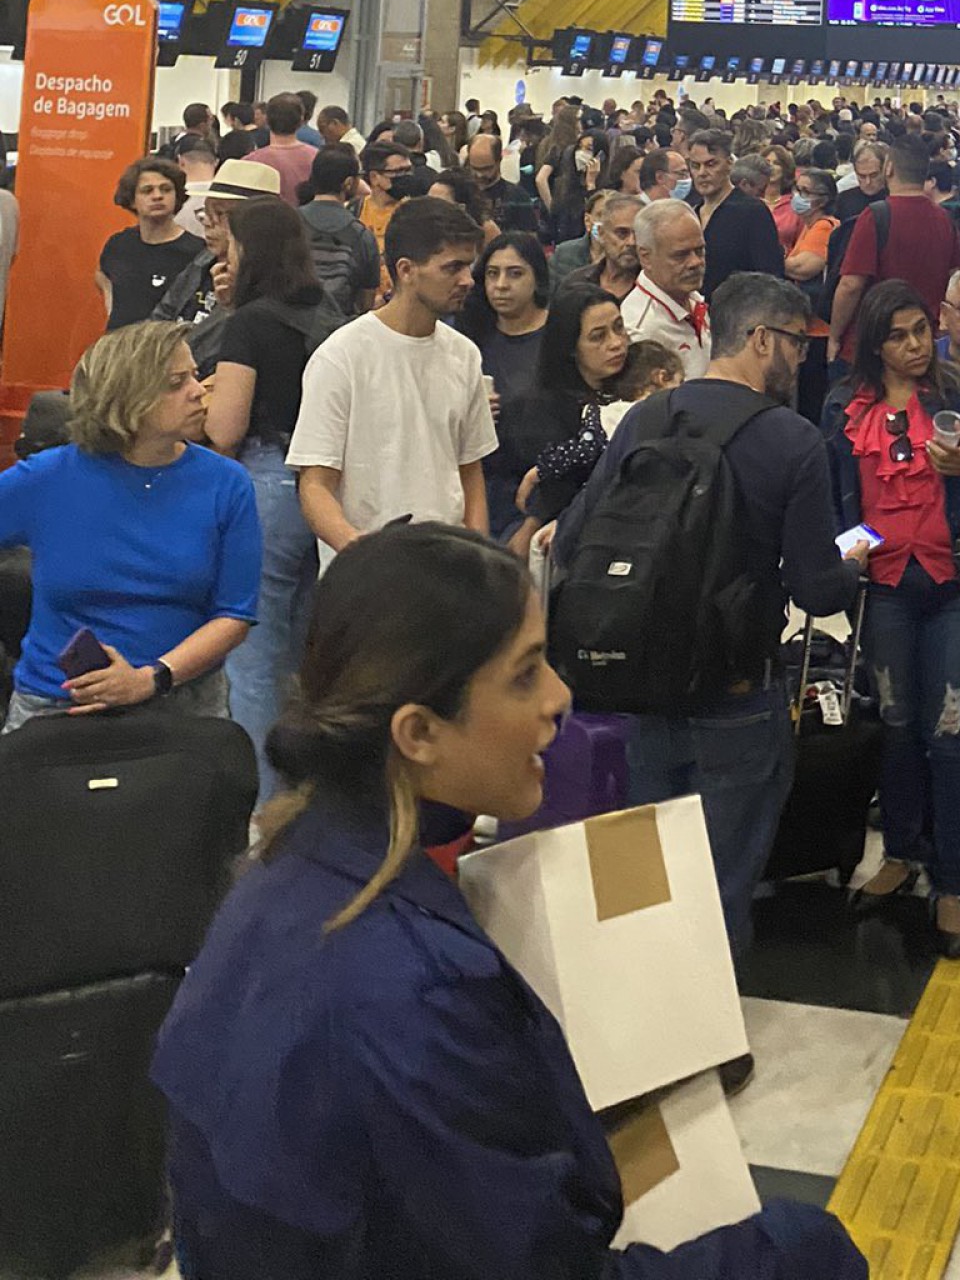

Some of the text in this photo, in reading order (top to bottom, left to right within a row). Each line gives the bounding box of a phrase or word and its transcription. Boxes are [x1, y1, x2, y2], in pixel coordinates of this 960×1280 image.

[103, 3, 147, 26] GOL
[309, 53, 323, 69] 51
[35, 72, 112, 95] Despacho
[33, 95, 130, 121] de Bagagem
